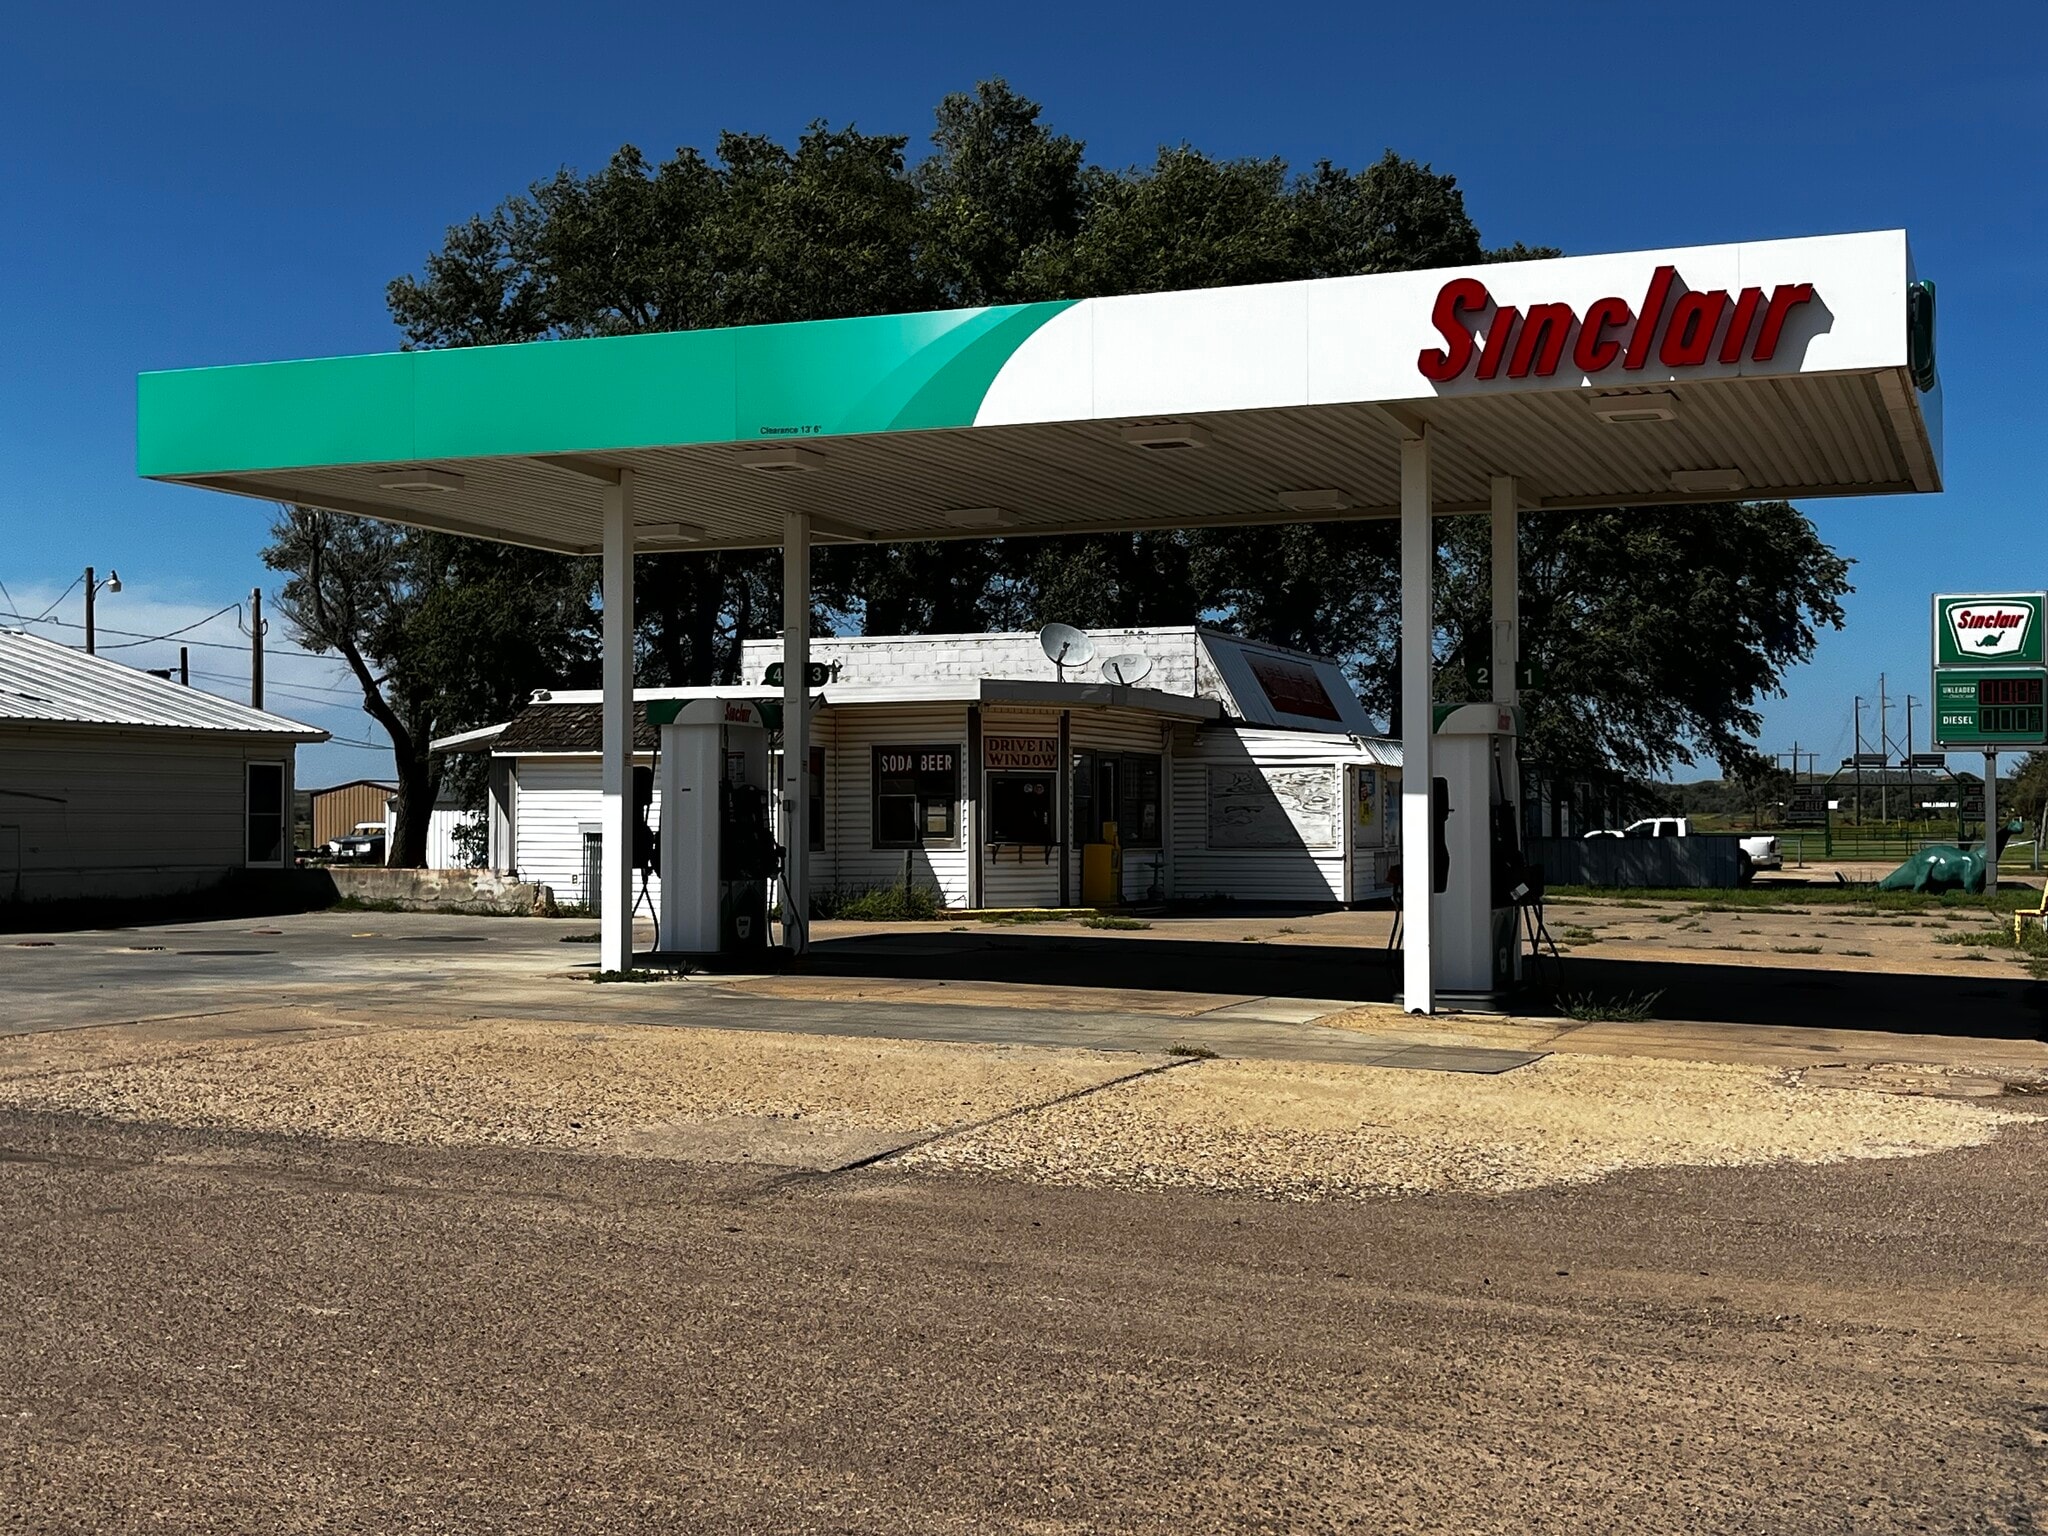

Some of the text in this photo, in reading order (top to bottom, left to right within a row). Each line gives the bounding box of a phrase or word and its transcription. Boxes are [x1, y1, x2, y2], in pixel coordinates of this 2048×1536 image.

[1417, 265, 1814, 382] Sinclair
[760, 426, 799, 435] Clearance
[1957, 610, 2024, 629] Sinclair
[773, 667, 783, 682] 4
[812, 667, 822, 682] 3
[1477, 667, 1488, 683] 2
[1523, 668, 1532, 685] 1
[1942, 686, 1976, 694] UNLEADED
[1943, 716, 1974, 725] DIESEL
[881, 754, 952, 772] SODA BEER
[988, 753, 1057, 766] WINDOW
